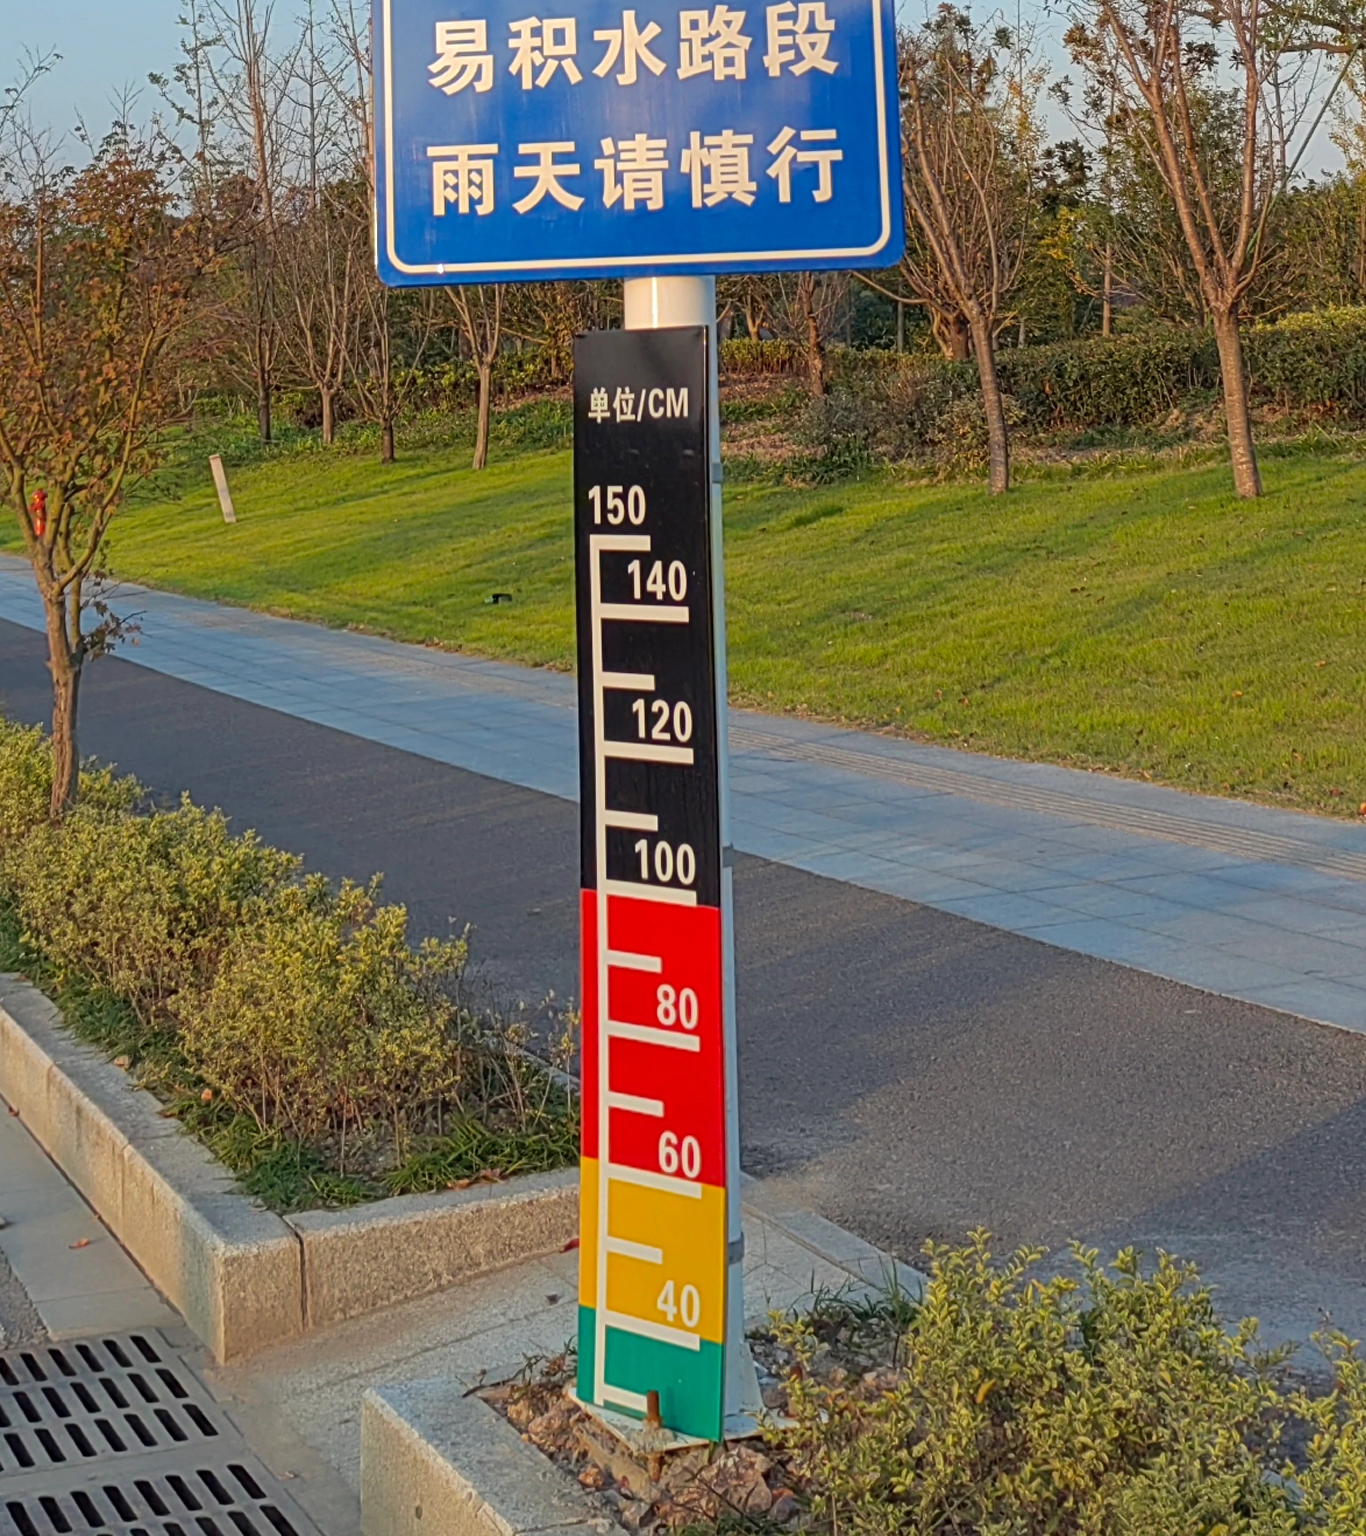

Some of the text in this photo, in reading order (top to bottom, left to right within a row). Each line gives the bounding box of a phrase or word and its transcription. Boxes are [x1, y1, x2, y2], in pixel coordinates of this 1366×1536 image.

[427, 1, 839, 96] 易积水路段
[426, 125, 843, 216] 雨天请慎行
[588, 386, 689, 424] 单位/CM
[588, 485, 646, 525] 150
[628, 560, 687, 601] 140
[632, 699, 693, 743] 120
[634, 838, 696, 885] 100
[656, 984, 698, 1030] 80
[658, 1131, 701, 1179] 60
[656, 1280, 700, 1327] 40
